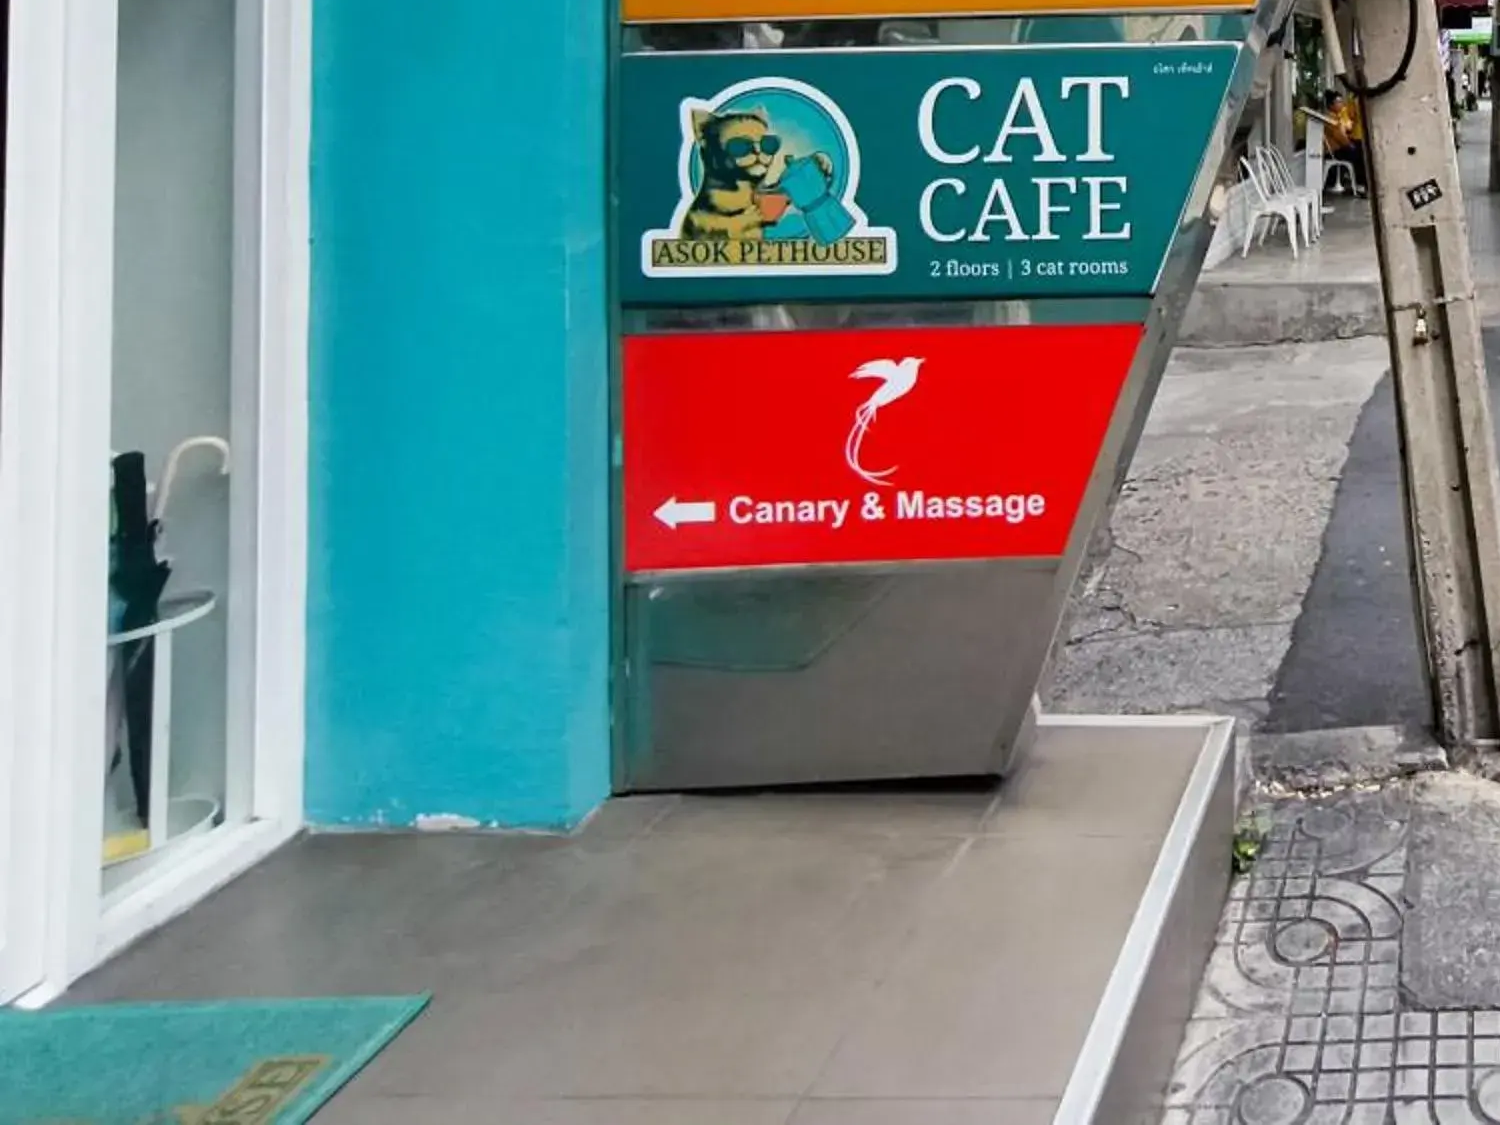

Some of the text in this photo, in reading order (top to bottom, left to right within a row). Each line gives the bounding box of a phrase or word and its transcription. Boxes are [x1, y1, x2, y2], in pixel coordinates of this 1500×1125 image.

[918, 77, 1129, 164] CAT
[919, 176, 1131, 242] CAFE
[656, 238, 885, 265] ASOK PETHOUSE
[929, 261, 941, 278] 2
[946, 258, 1000, 277] floors
[1020, 259, 1032, 276] 3
[1036, 261, 1064, 276] cat
[1068, 261, 1129, 276] rooms
[729, 490, 1045, 528] Canary & Massage
